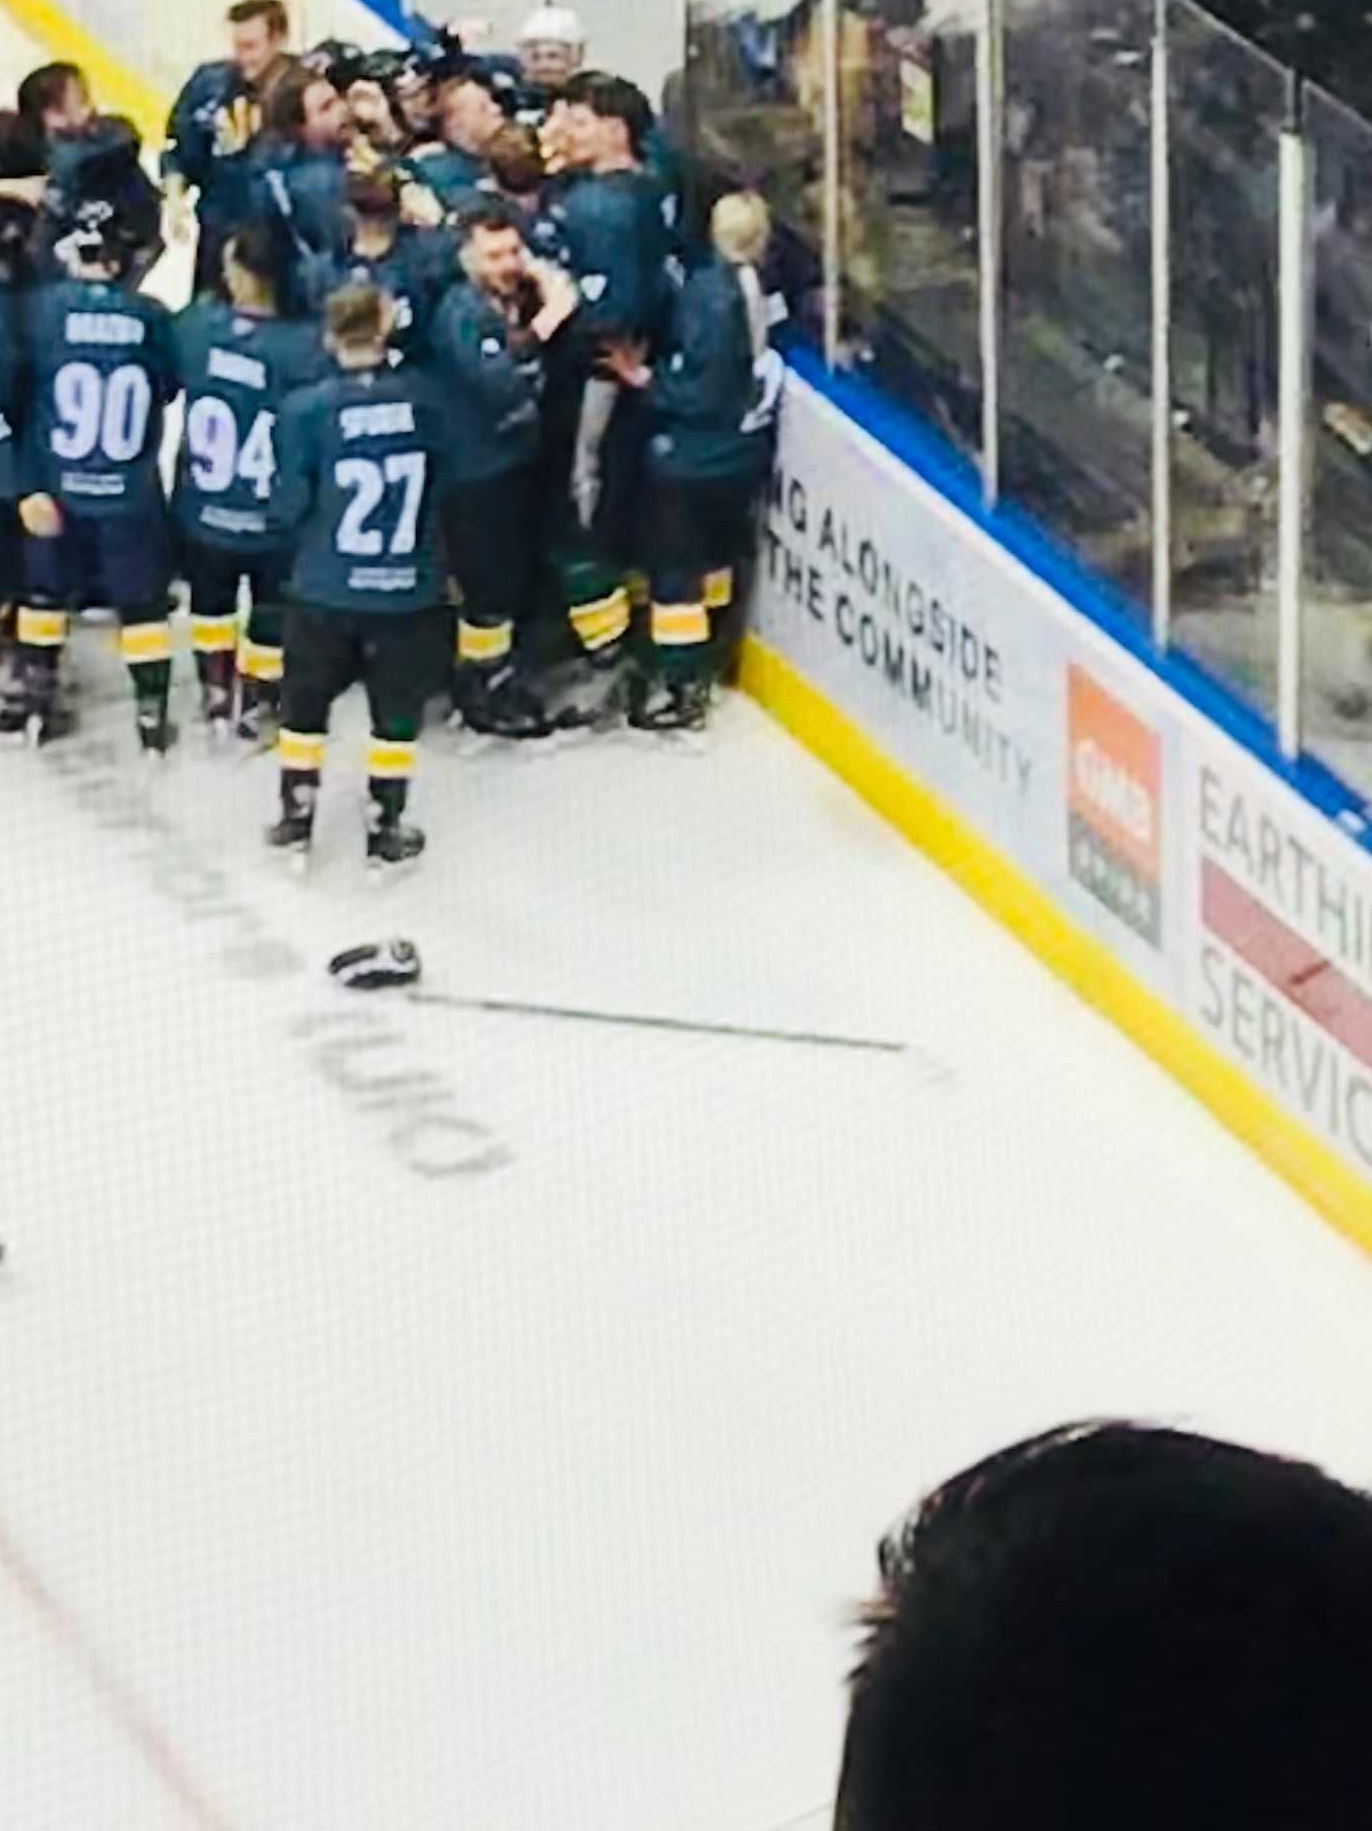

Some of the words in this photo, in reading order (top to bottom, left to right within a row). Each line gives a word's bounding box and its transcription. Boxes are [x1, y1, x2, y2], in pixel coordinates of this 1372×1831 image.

[49, 361, 152, 461] 90
[187, 394, 278, 499] 94
[334, 451, 427, 555] 27
[818, 507, 1002, 704] ALONGSIDE
[763, 521, 826, 621] THE
[835, 594, 1032, 797] COMMUNITY
